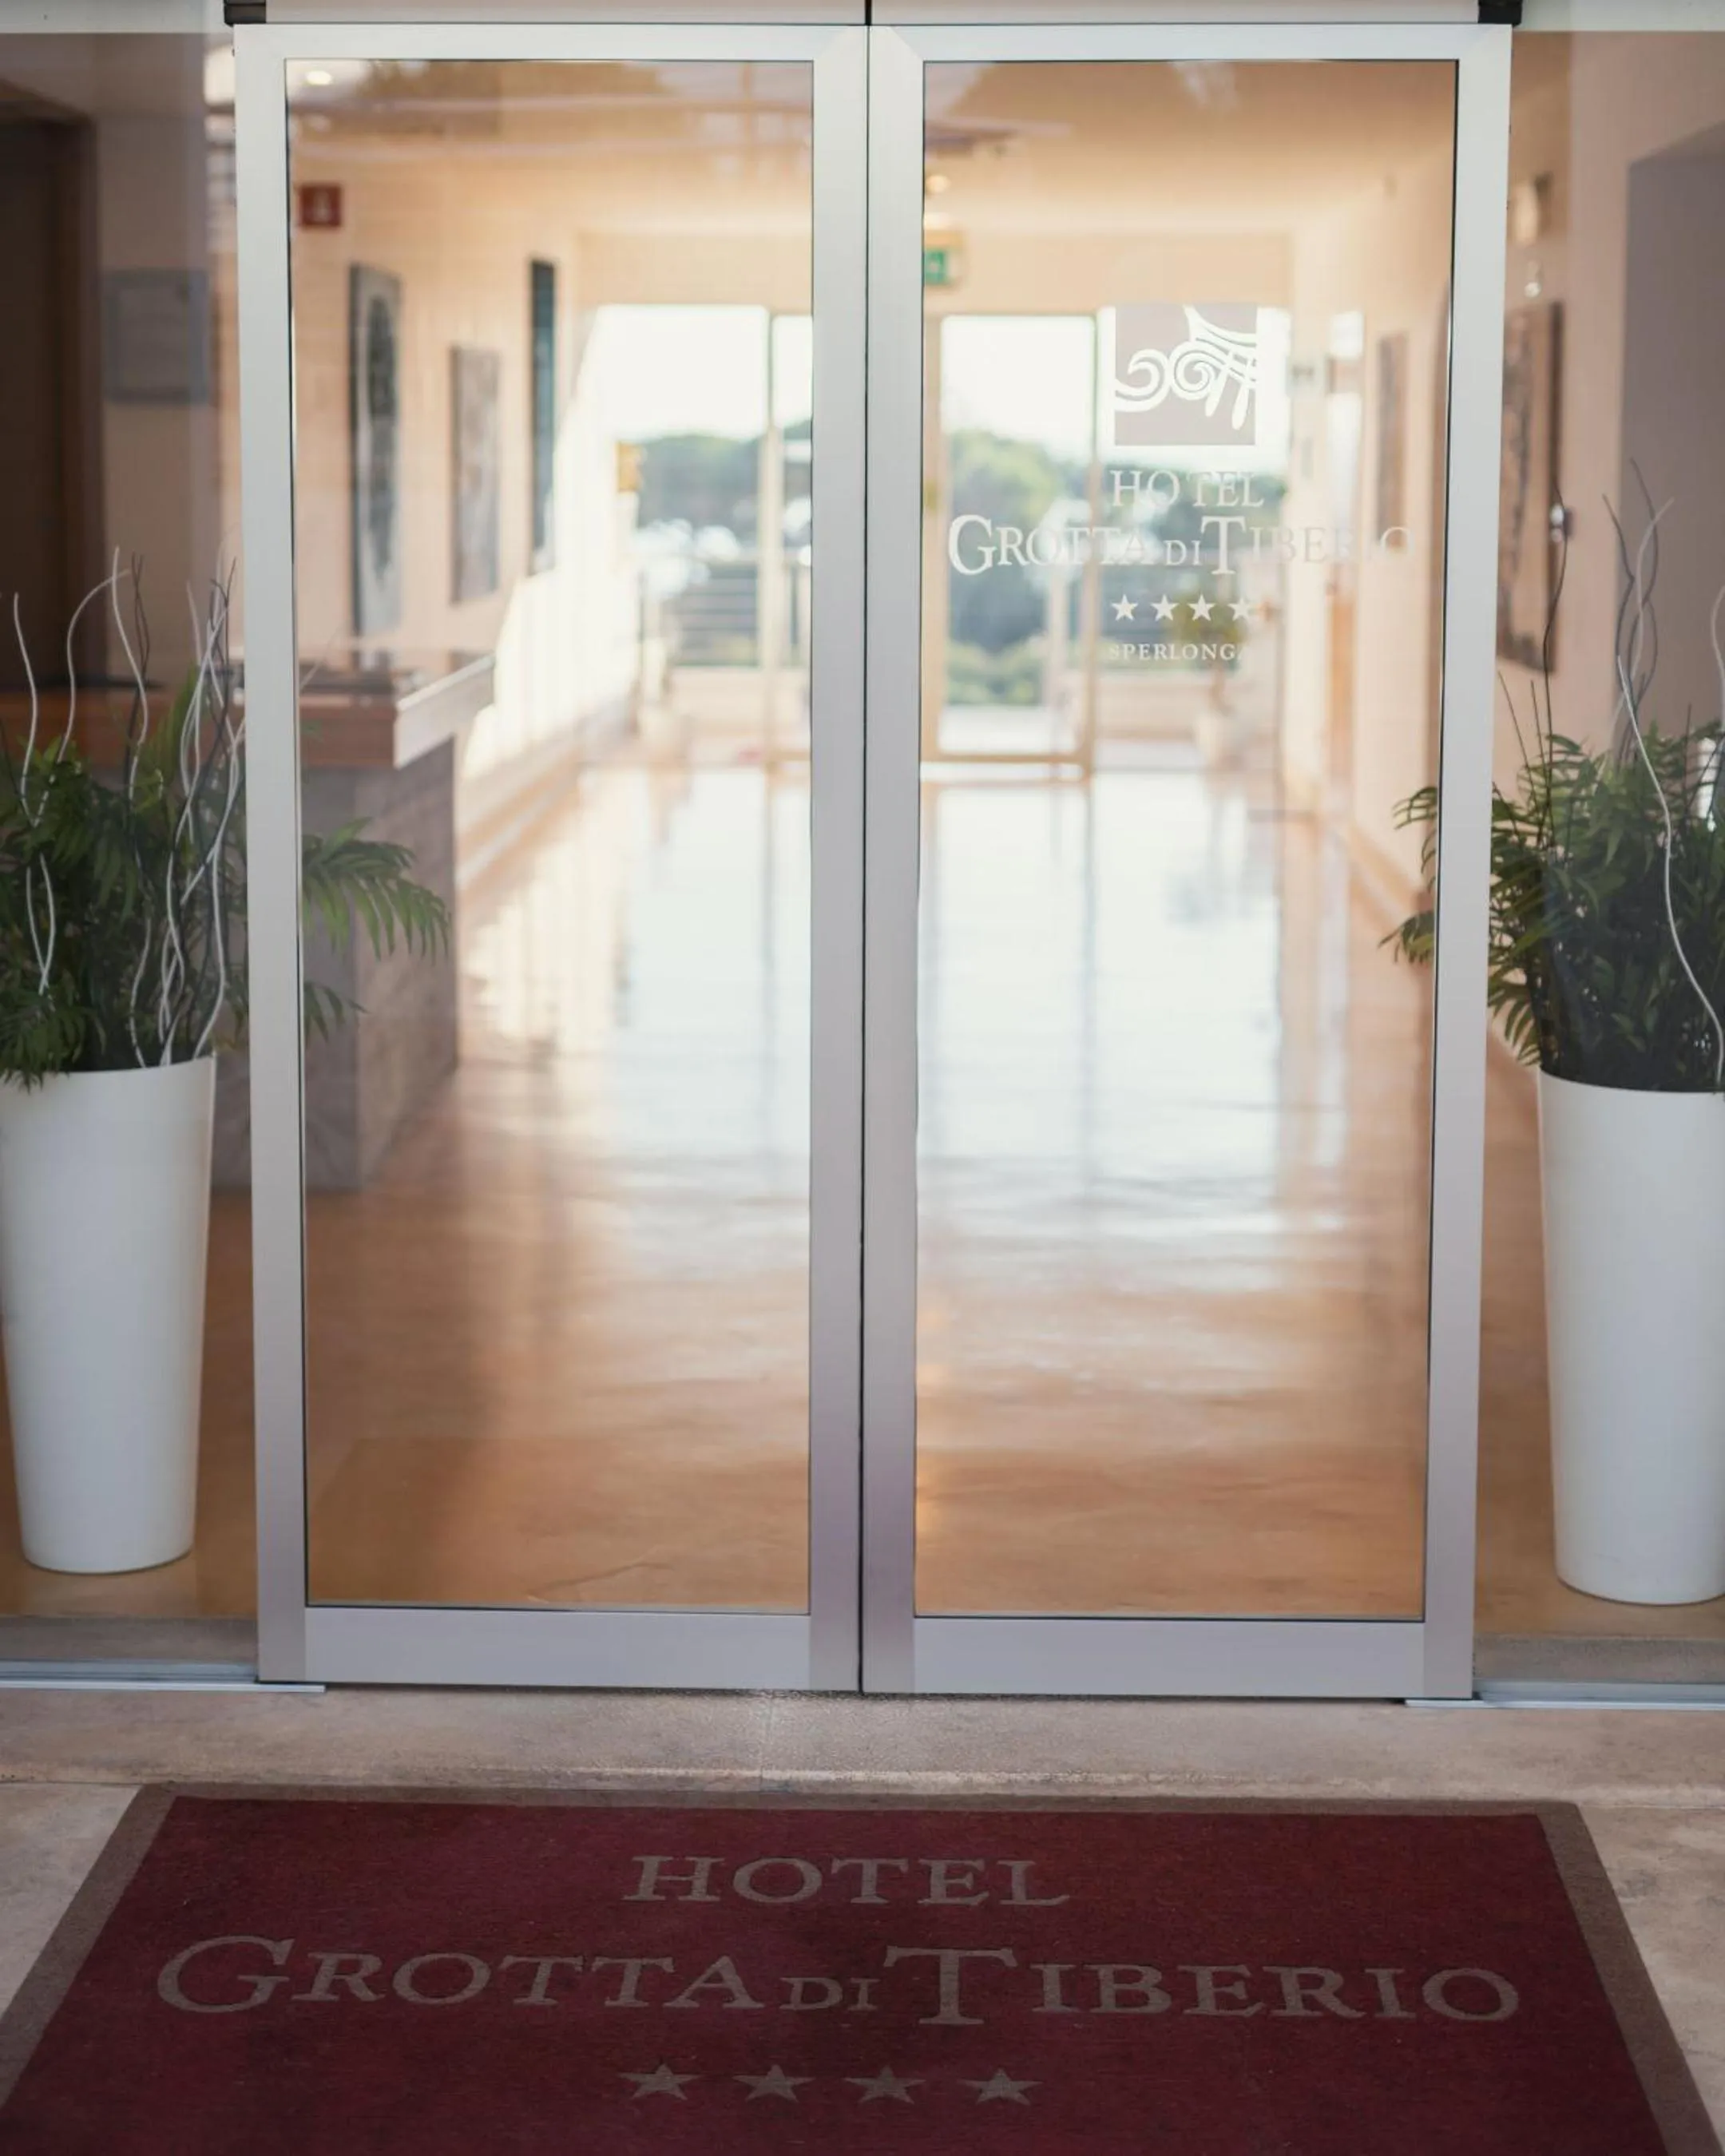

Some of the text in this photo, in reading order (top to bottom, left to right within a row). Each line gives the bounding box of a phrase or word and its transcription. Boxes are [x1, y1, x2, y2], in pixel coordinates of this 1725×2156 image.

[1109, 469, 1265, 508] HOTEL
[948, 513, 1156, 576] GROTTA
[1164, 539, 1202, 566] DI
[1108, 643, 1247, 661] SPERLONG
[623, 1855, 1070, 1907] HOTEL
[157, 1935, 1520, 2026] GROTTA DI TIBERIO
